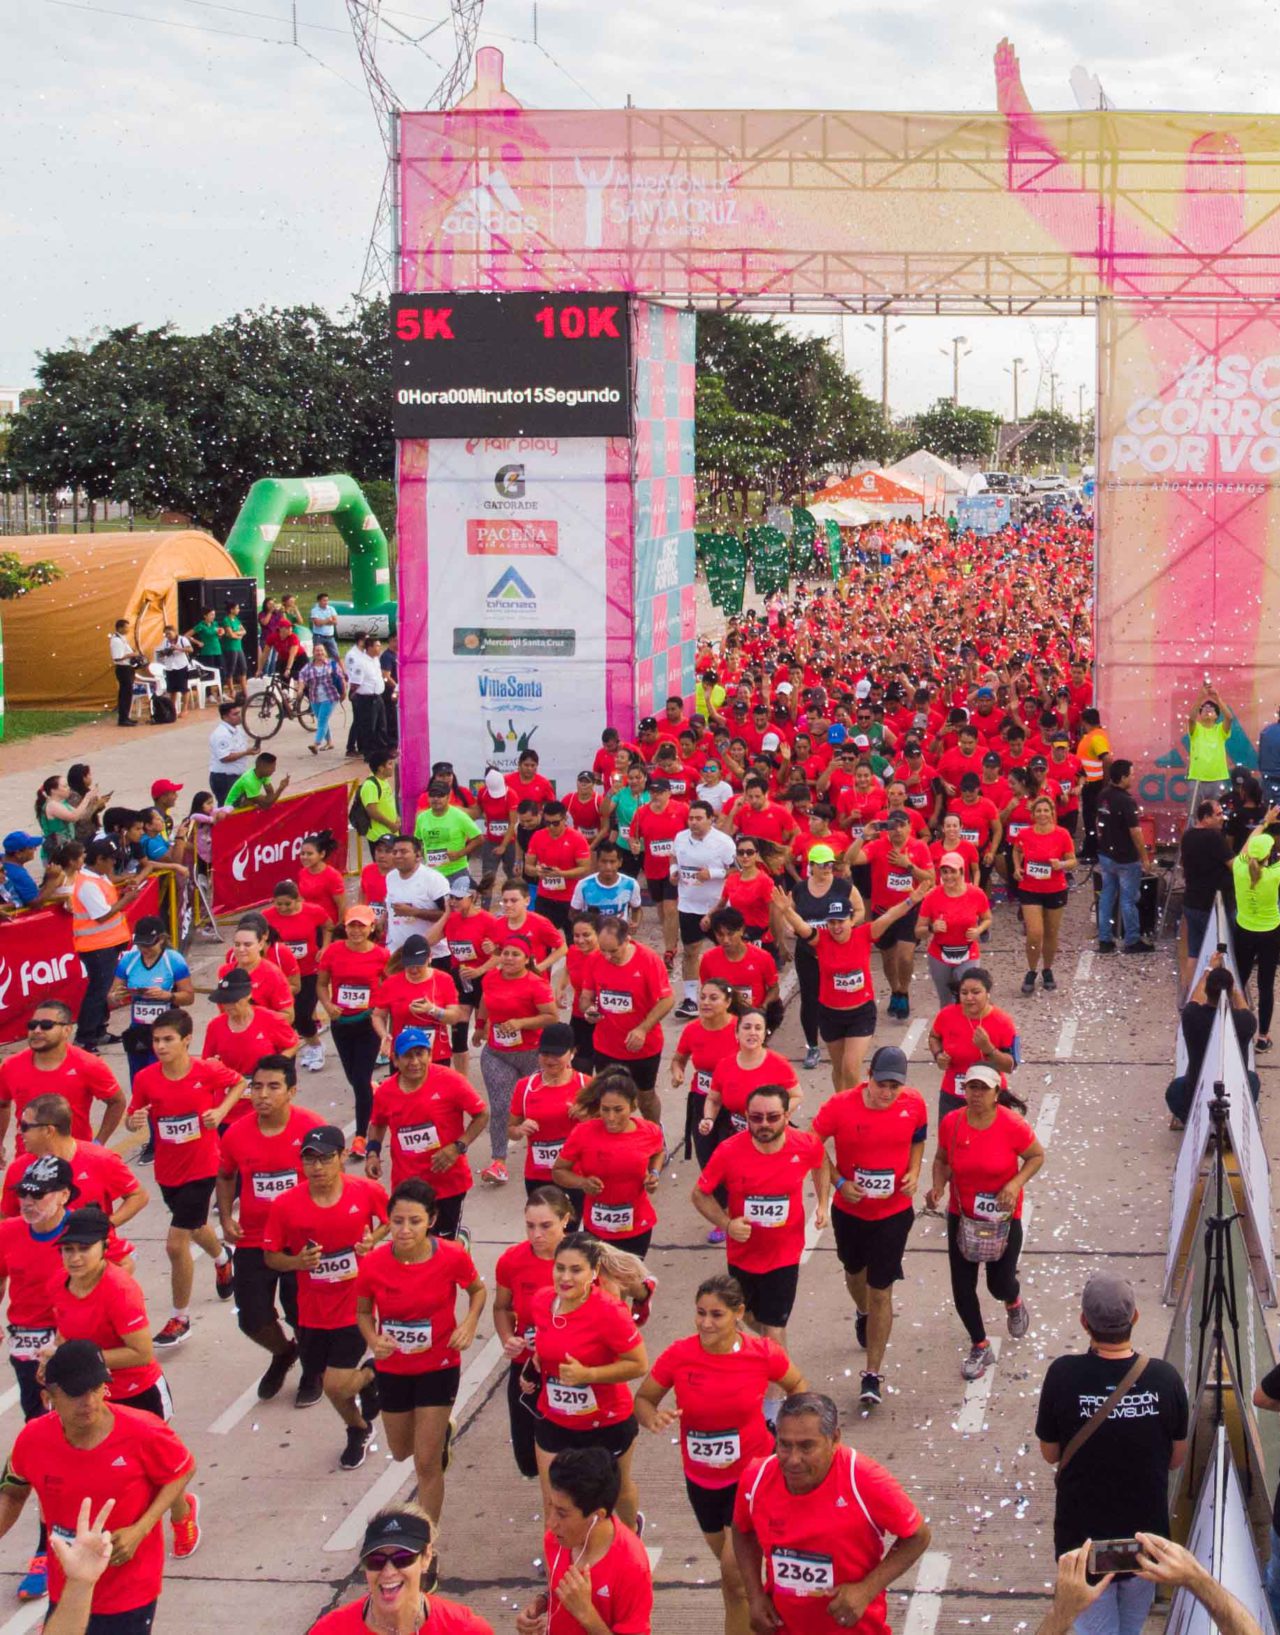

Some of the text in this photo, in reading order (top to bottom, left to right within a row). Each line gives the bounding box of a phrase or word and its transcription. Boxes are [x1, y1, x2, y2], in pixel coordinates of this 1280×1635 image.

[610, 199, 740, 224] SANTA CRUZ
[442, 211, 538, 234] adidas
[396, 306, 621, 340] 5K 10K
[398, 387, 620, 405] 0Hora00Minuto15Segundo
[1108, 436, 1209, 474] POR
[484, 501, 539, 510] GATORADE
[477, 524, 548, 541] PACEÑA
[484, 637, 565, 648] Mercantil Santa Cruz
[652, 843, 671, 852] 3140
[253, 844, 290, 872] fair
[20, 953, 75, 997] fair
[836, 976, 861, 988] 2644
[342, 991, 365, 1001] 3134
[602, 996, 630, 1007] 3476
[135, 1007, 164, 1017] 3540
[166, 1122, 192, 1134] 3191
[404, 1134, 430, 1144] 1194
[256, 1179, 295, 1192] 3485
[858, 1177, 890, 1189] 2622
[750, 1204, 783, 1216] 3142
[594, 1213, 629, 1224] 3425
[553, 1389, 587, 1405] 3219
[692, 1440, 734, 1455] 2375
[777, 1562, 828, 1583] 2362
